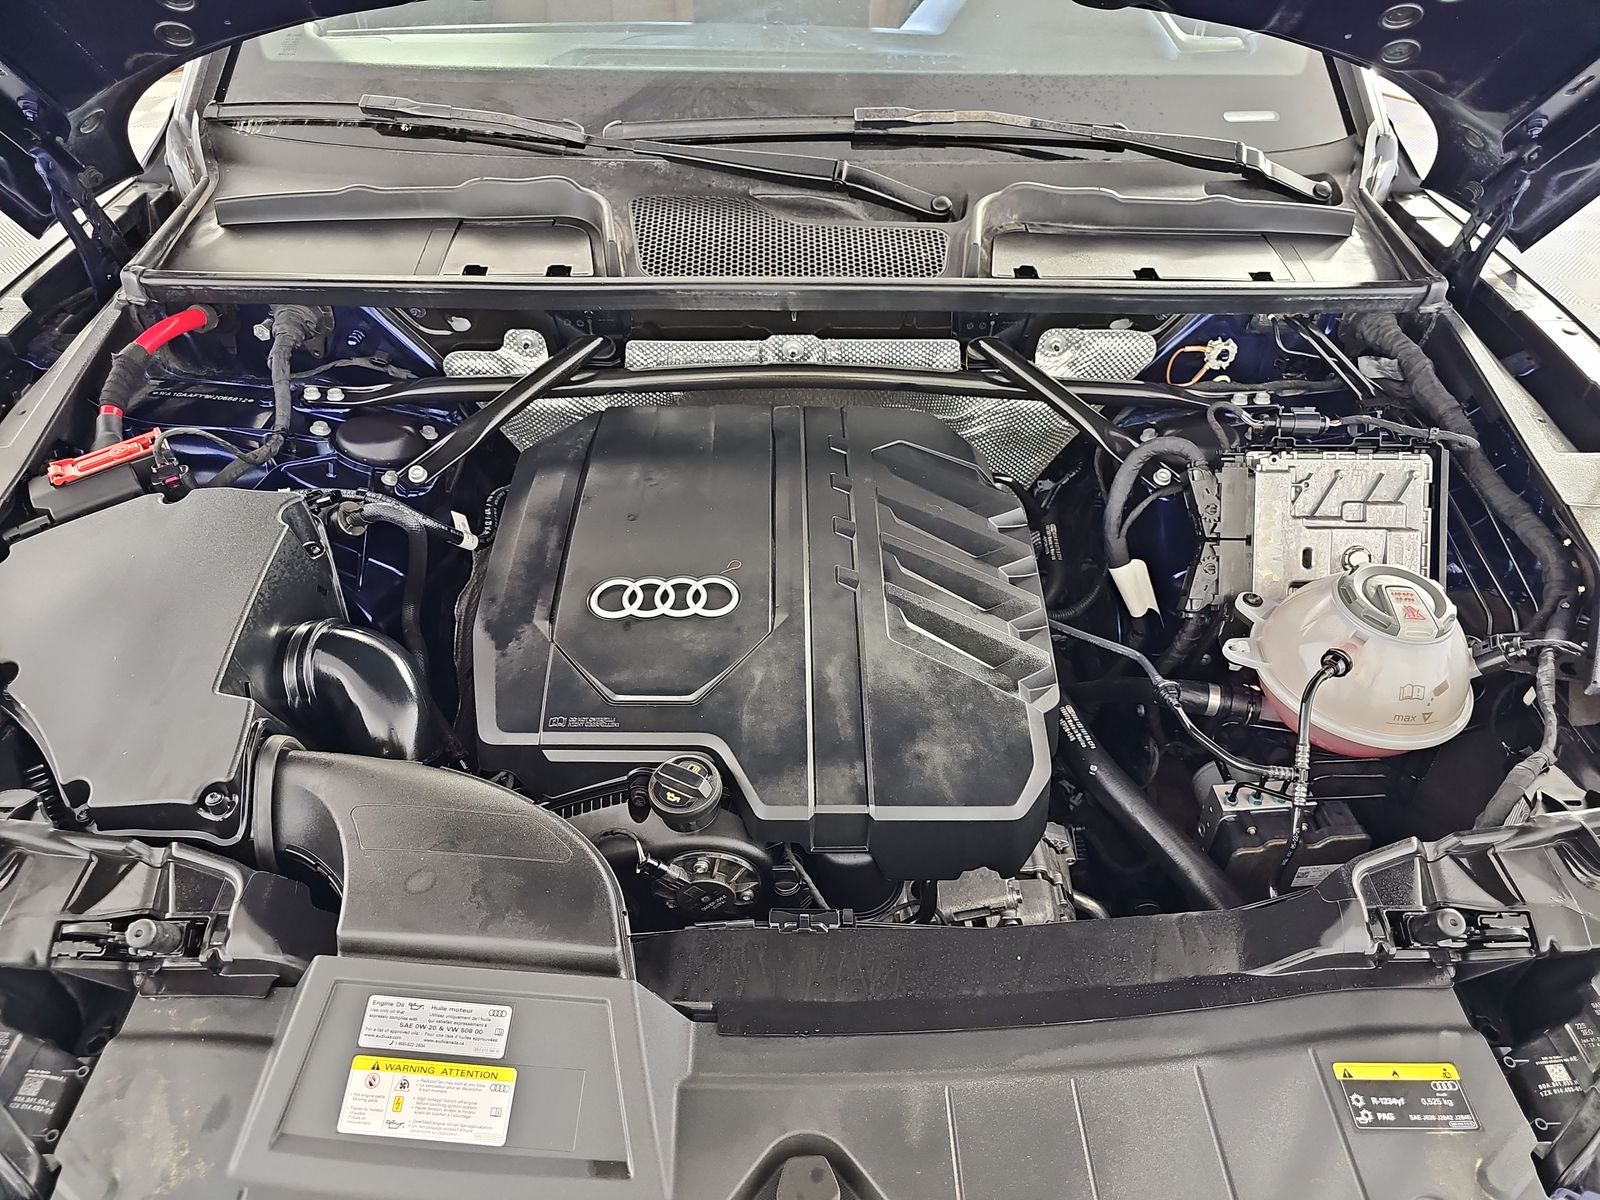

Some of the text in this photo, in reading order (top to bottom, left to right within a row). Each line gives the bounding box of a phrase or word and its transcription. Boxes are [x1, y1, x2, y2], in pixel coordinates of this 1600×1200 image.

[1393, 713, 1417, 722] max
[384, 1062, 498, 1079] WARNING ATTENTION
[1371, 1097, 1405, 1107] R-1234yf
[1421, 1097, 1454, 1107] 0,525 kg
